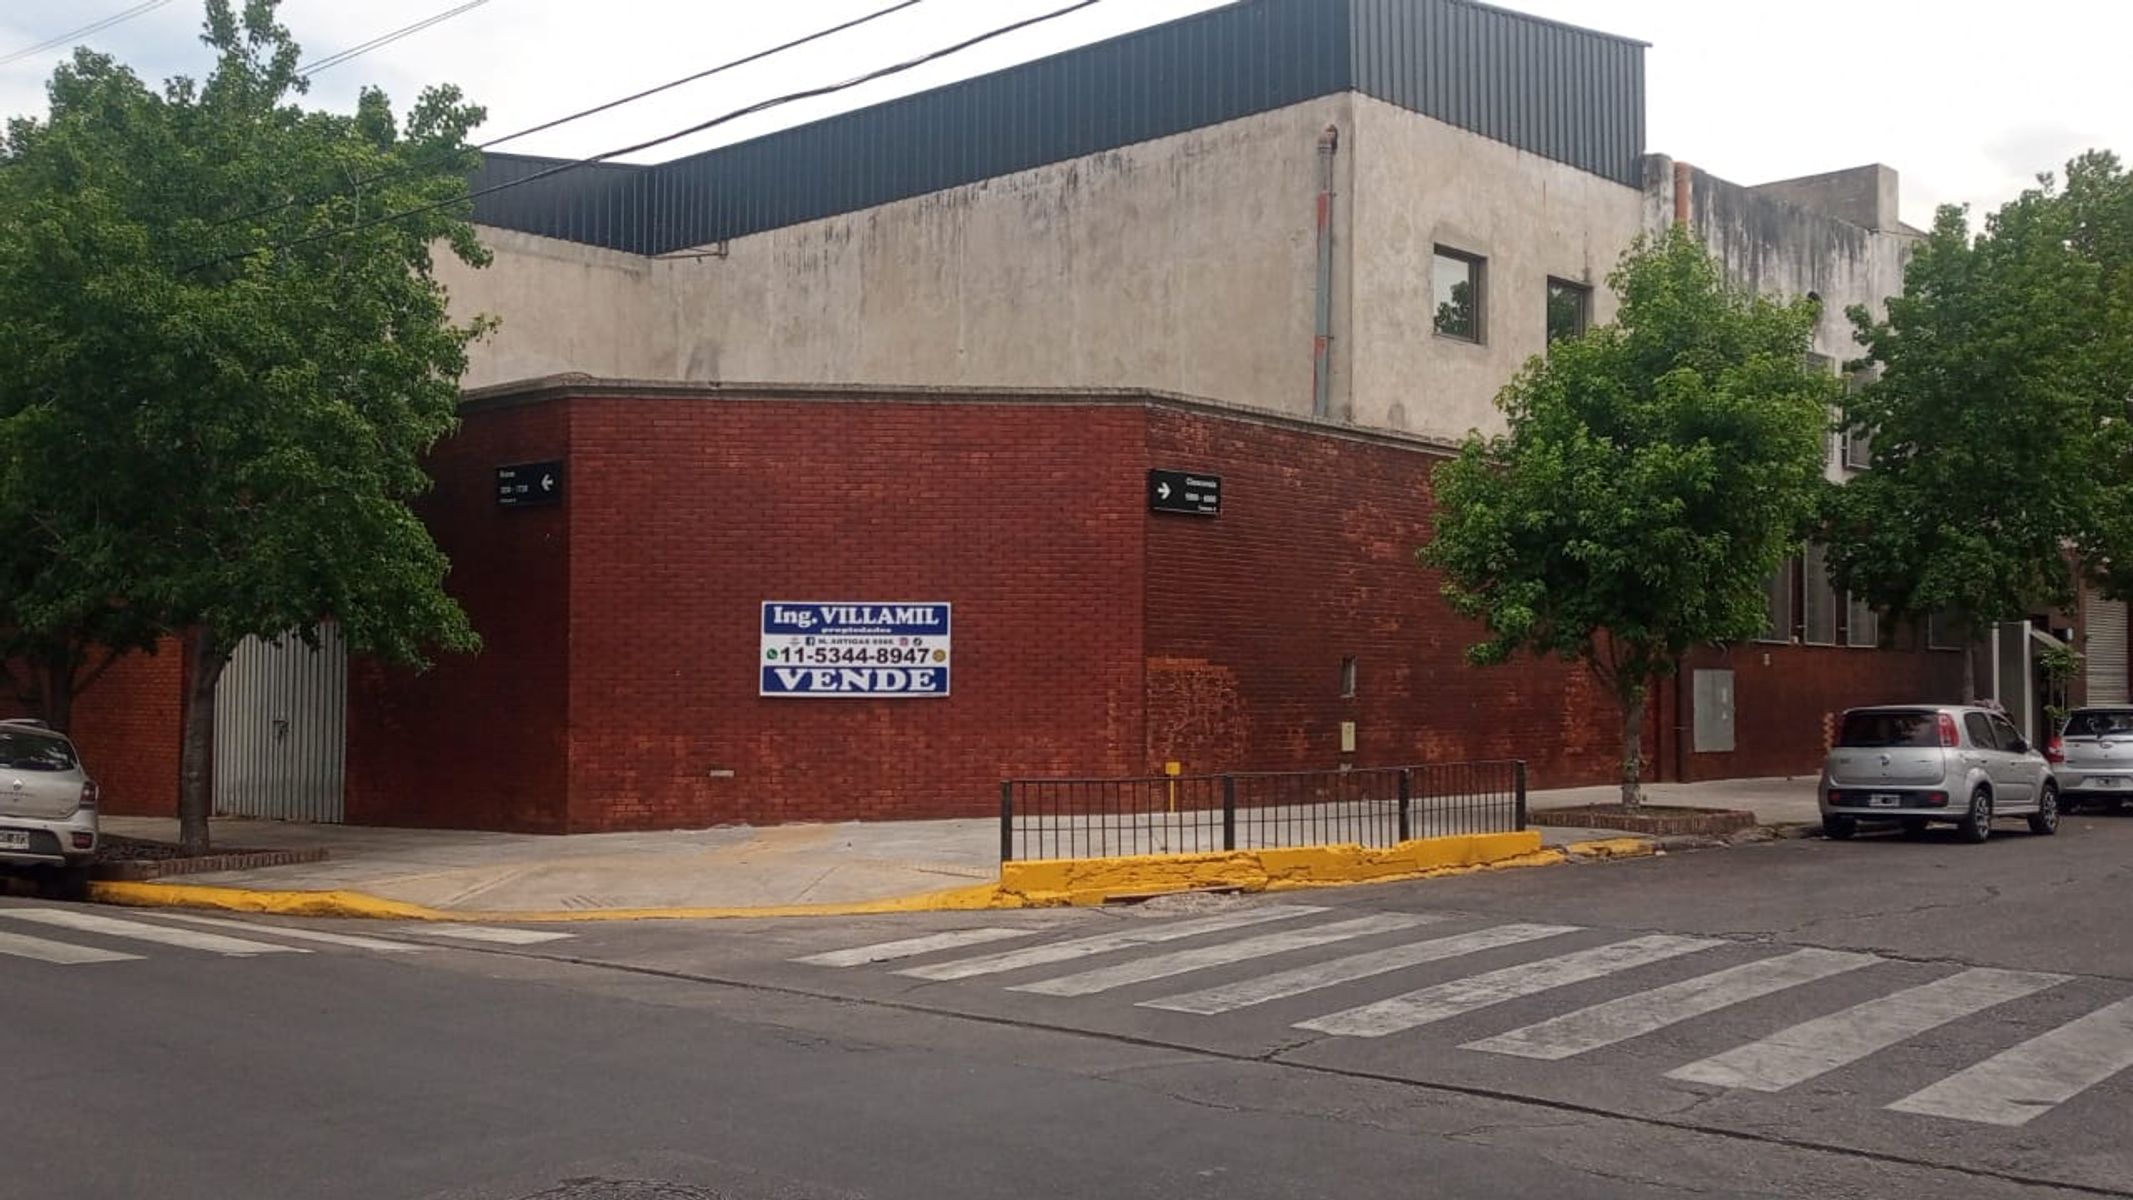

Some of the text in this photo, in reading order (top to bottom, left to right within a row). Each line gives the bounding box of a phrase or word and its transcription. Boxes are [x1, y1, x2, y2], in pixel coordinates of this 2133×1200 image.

[773, 606, 940, 628] Ing. VILLAMIL
[780, 646, 930, 664] 11-5344-8947
[773, 668, 937, 691] VENDE
